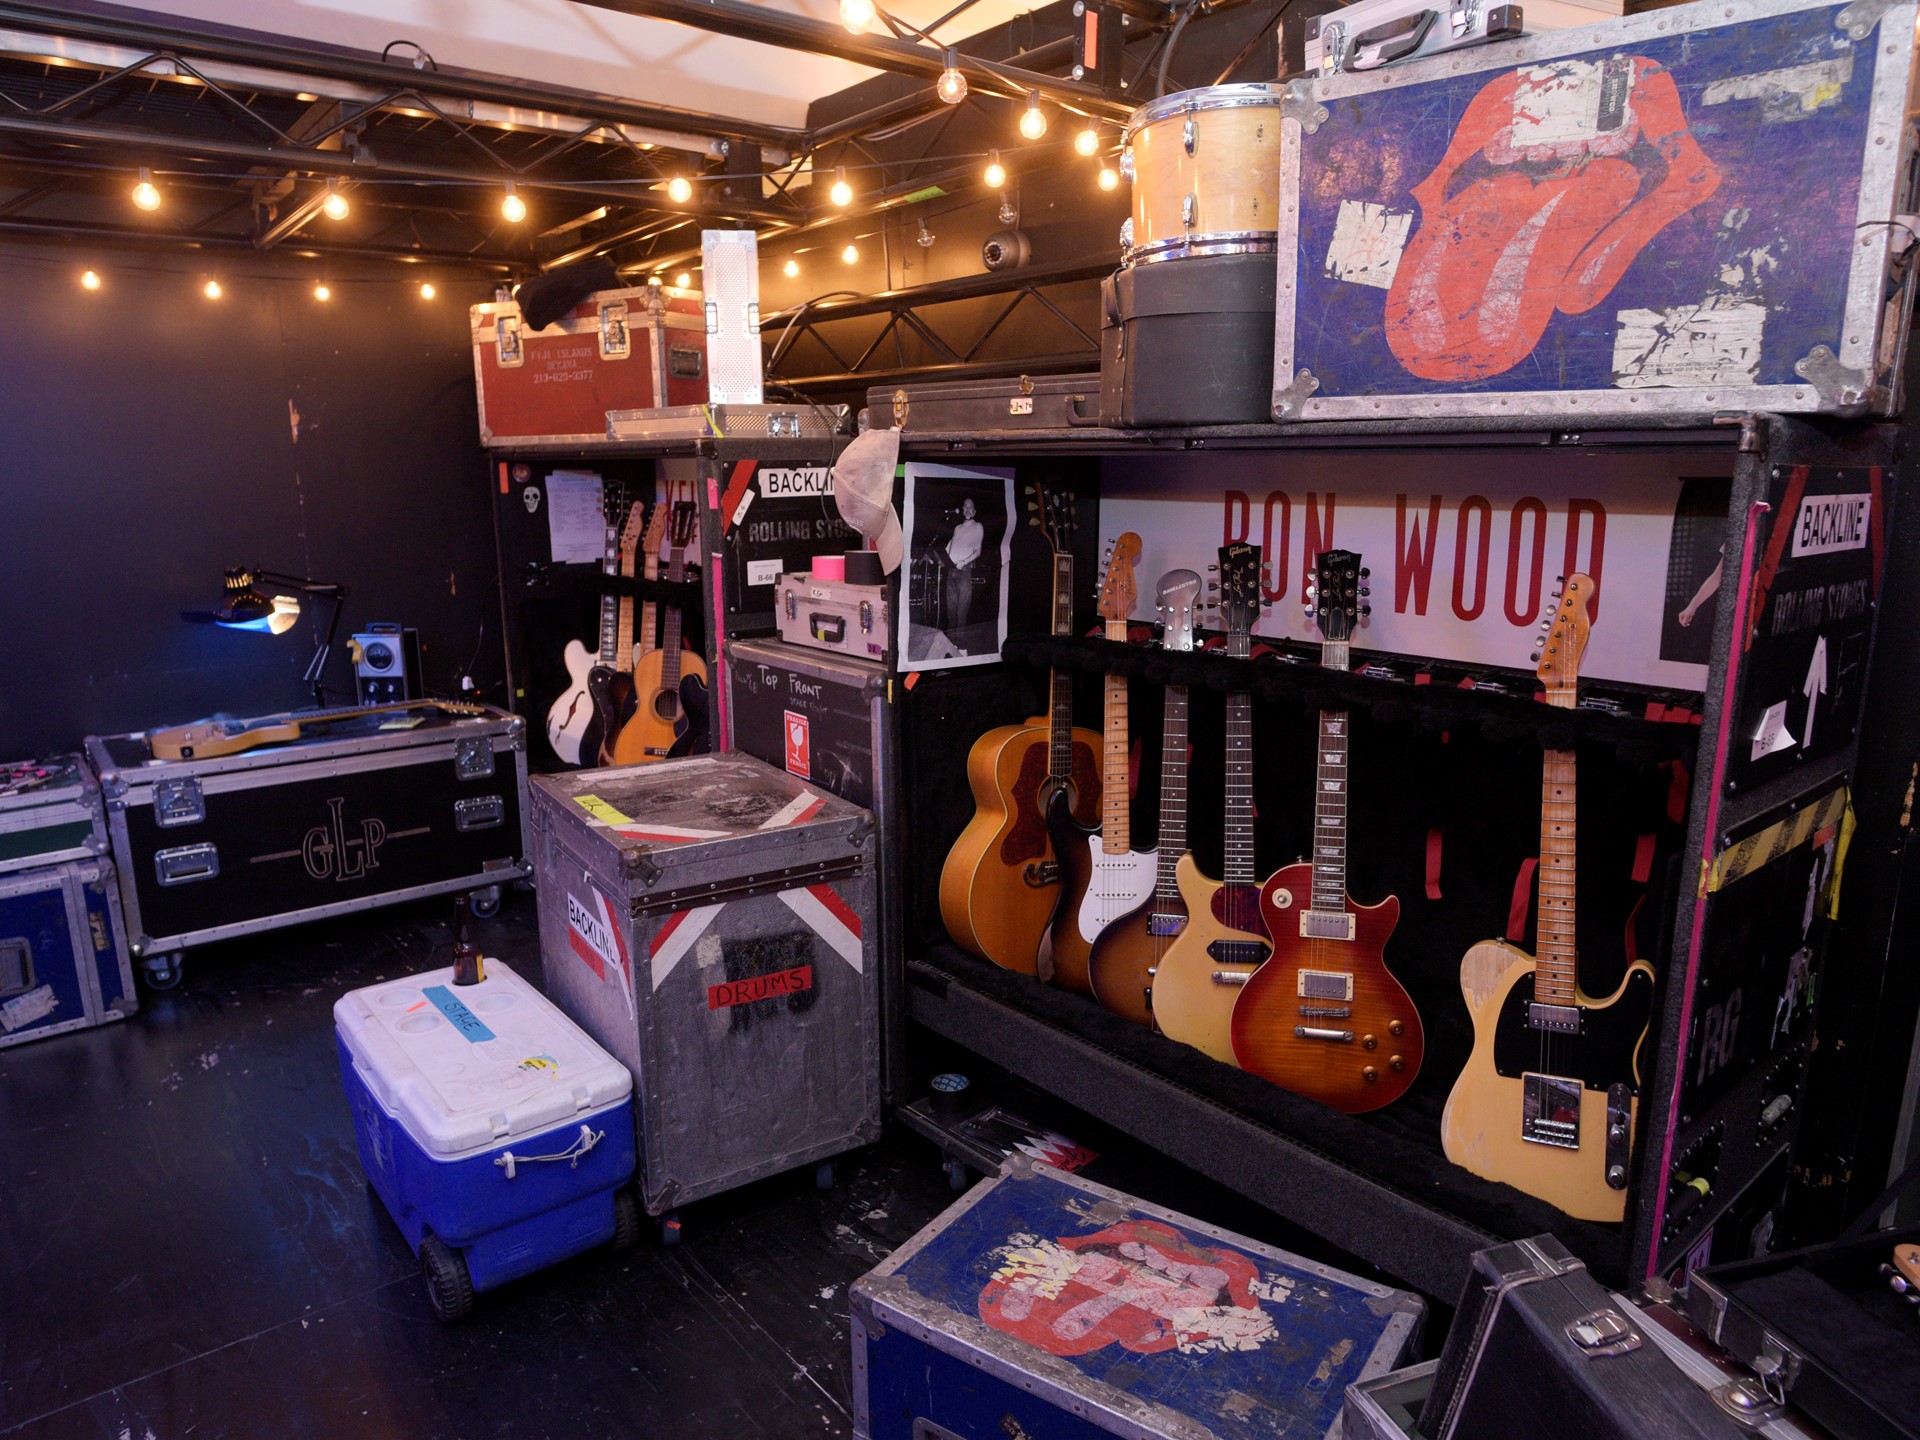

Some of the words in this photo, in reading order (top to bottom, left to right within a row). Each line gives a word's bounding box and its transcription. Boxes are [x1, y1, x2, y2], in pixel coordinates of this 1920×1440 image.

[557, 347, 592, 358] ISLANDS
[748, 522, 810, 542] ROLLING
[1800, 501, 1865, 548] BACKLINE
[1223, 489, 1336, 606] RON
[1394, 493, 1607, 627] WOOD
[1229, 545, 1252, 559] Gibson
[1327, 553, 1351, 566] Gibson
[757, 573, 774, 582] B-66
[1162, 579, 1197, 595] DANELECTRO
[1771, 585, 1826, 637] ROLLING
[1827, 578, 1868, 621] STONES
[788, 673, 823, 700] FRONT
[786, 715, 808, 726] FRAGILE
[303, 797, 386, 882] GLP
[717, 969, 804, 1006] DRUMS
[444, 1002, 481, 1032] STAGE
